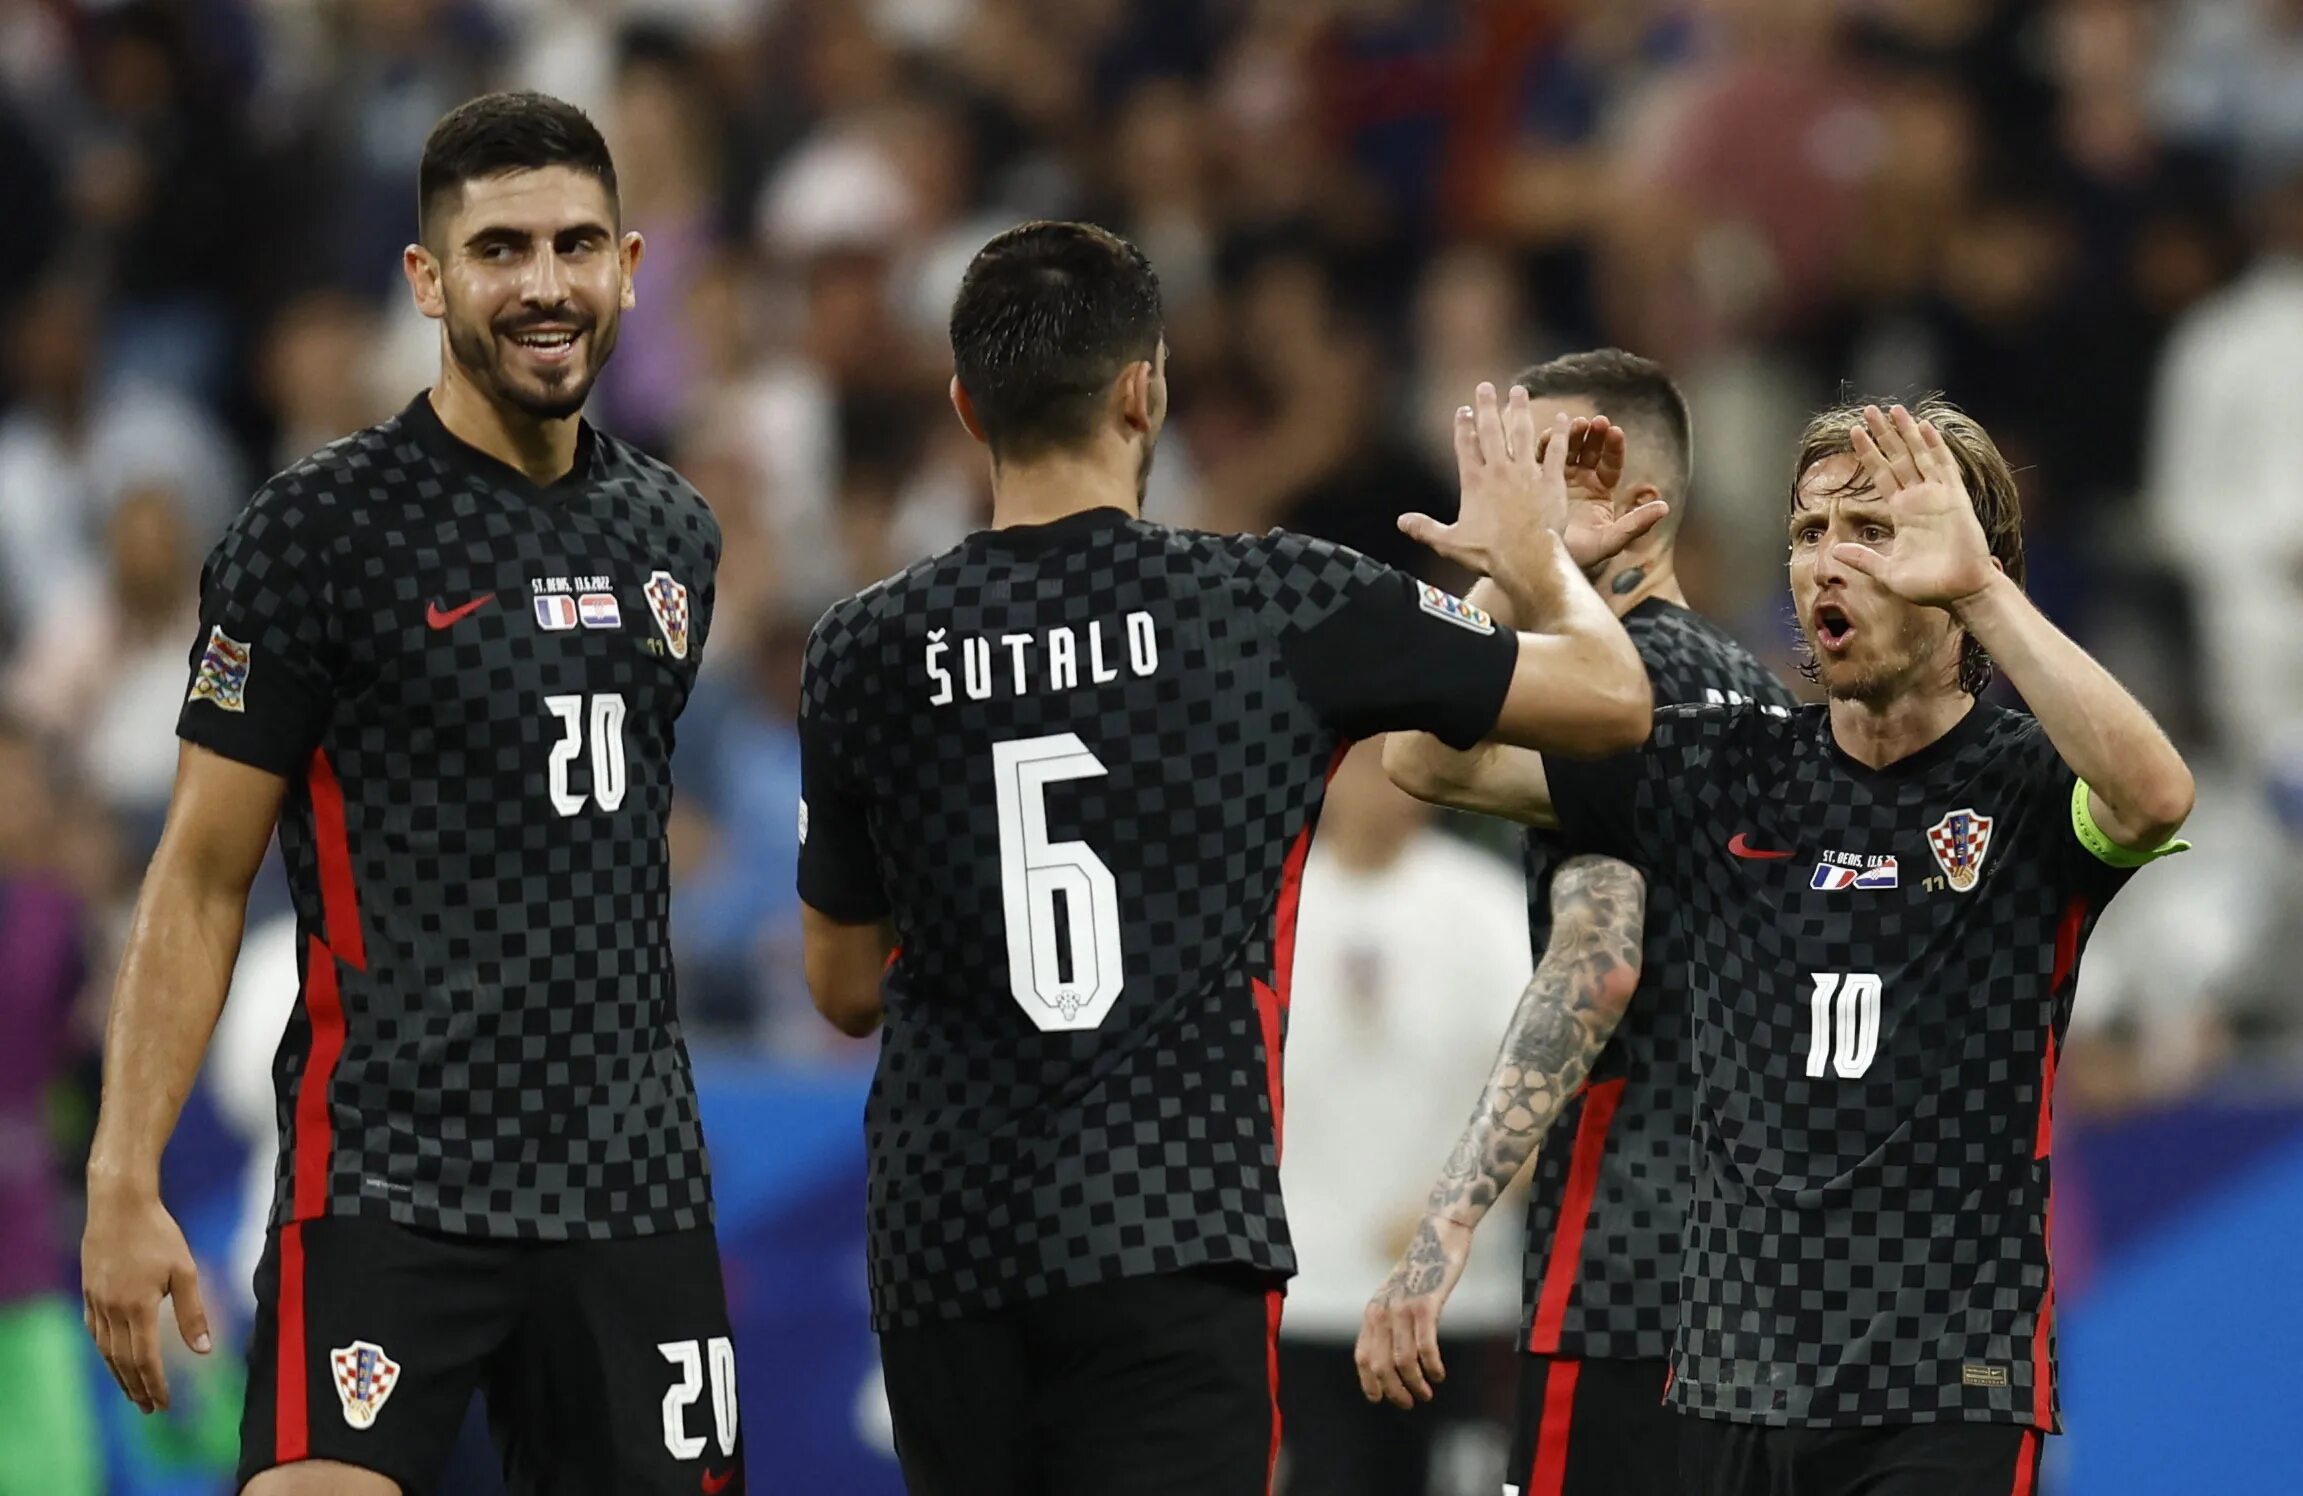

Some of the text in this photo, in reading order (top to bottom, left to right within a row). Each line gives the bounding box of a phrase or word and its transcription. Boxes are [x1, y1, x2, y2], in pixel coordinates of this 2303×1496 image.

[926, 611, 1159, 706] ŠUTALO
[543, 694, 626, 817] 20
[992, 732, 1124, 1032] 6
[1822, 850, 1836, 863] ST.
[1837, 852, 1864, 868] DENIS,
[1921, 875, 1945, 893] 11
[1805, 972, 1883, 1079] 10
[657, 1336, 738, 1460] 20
